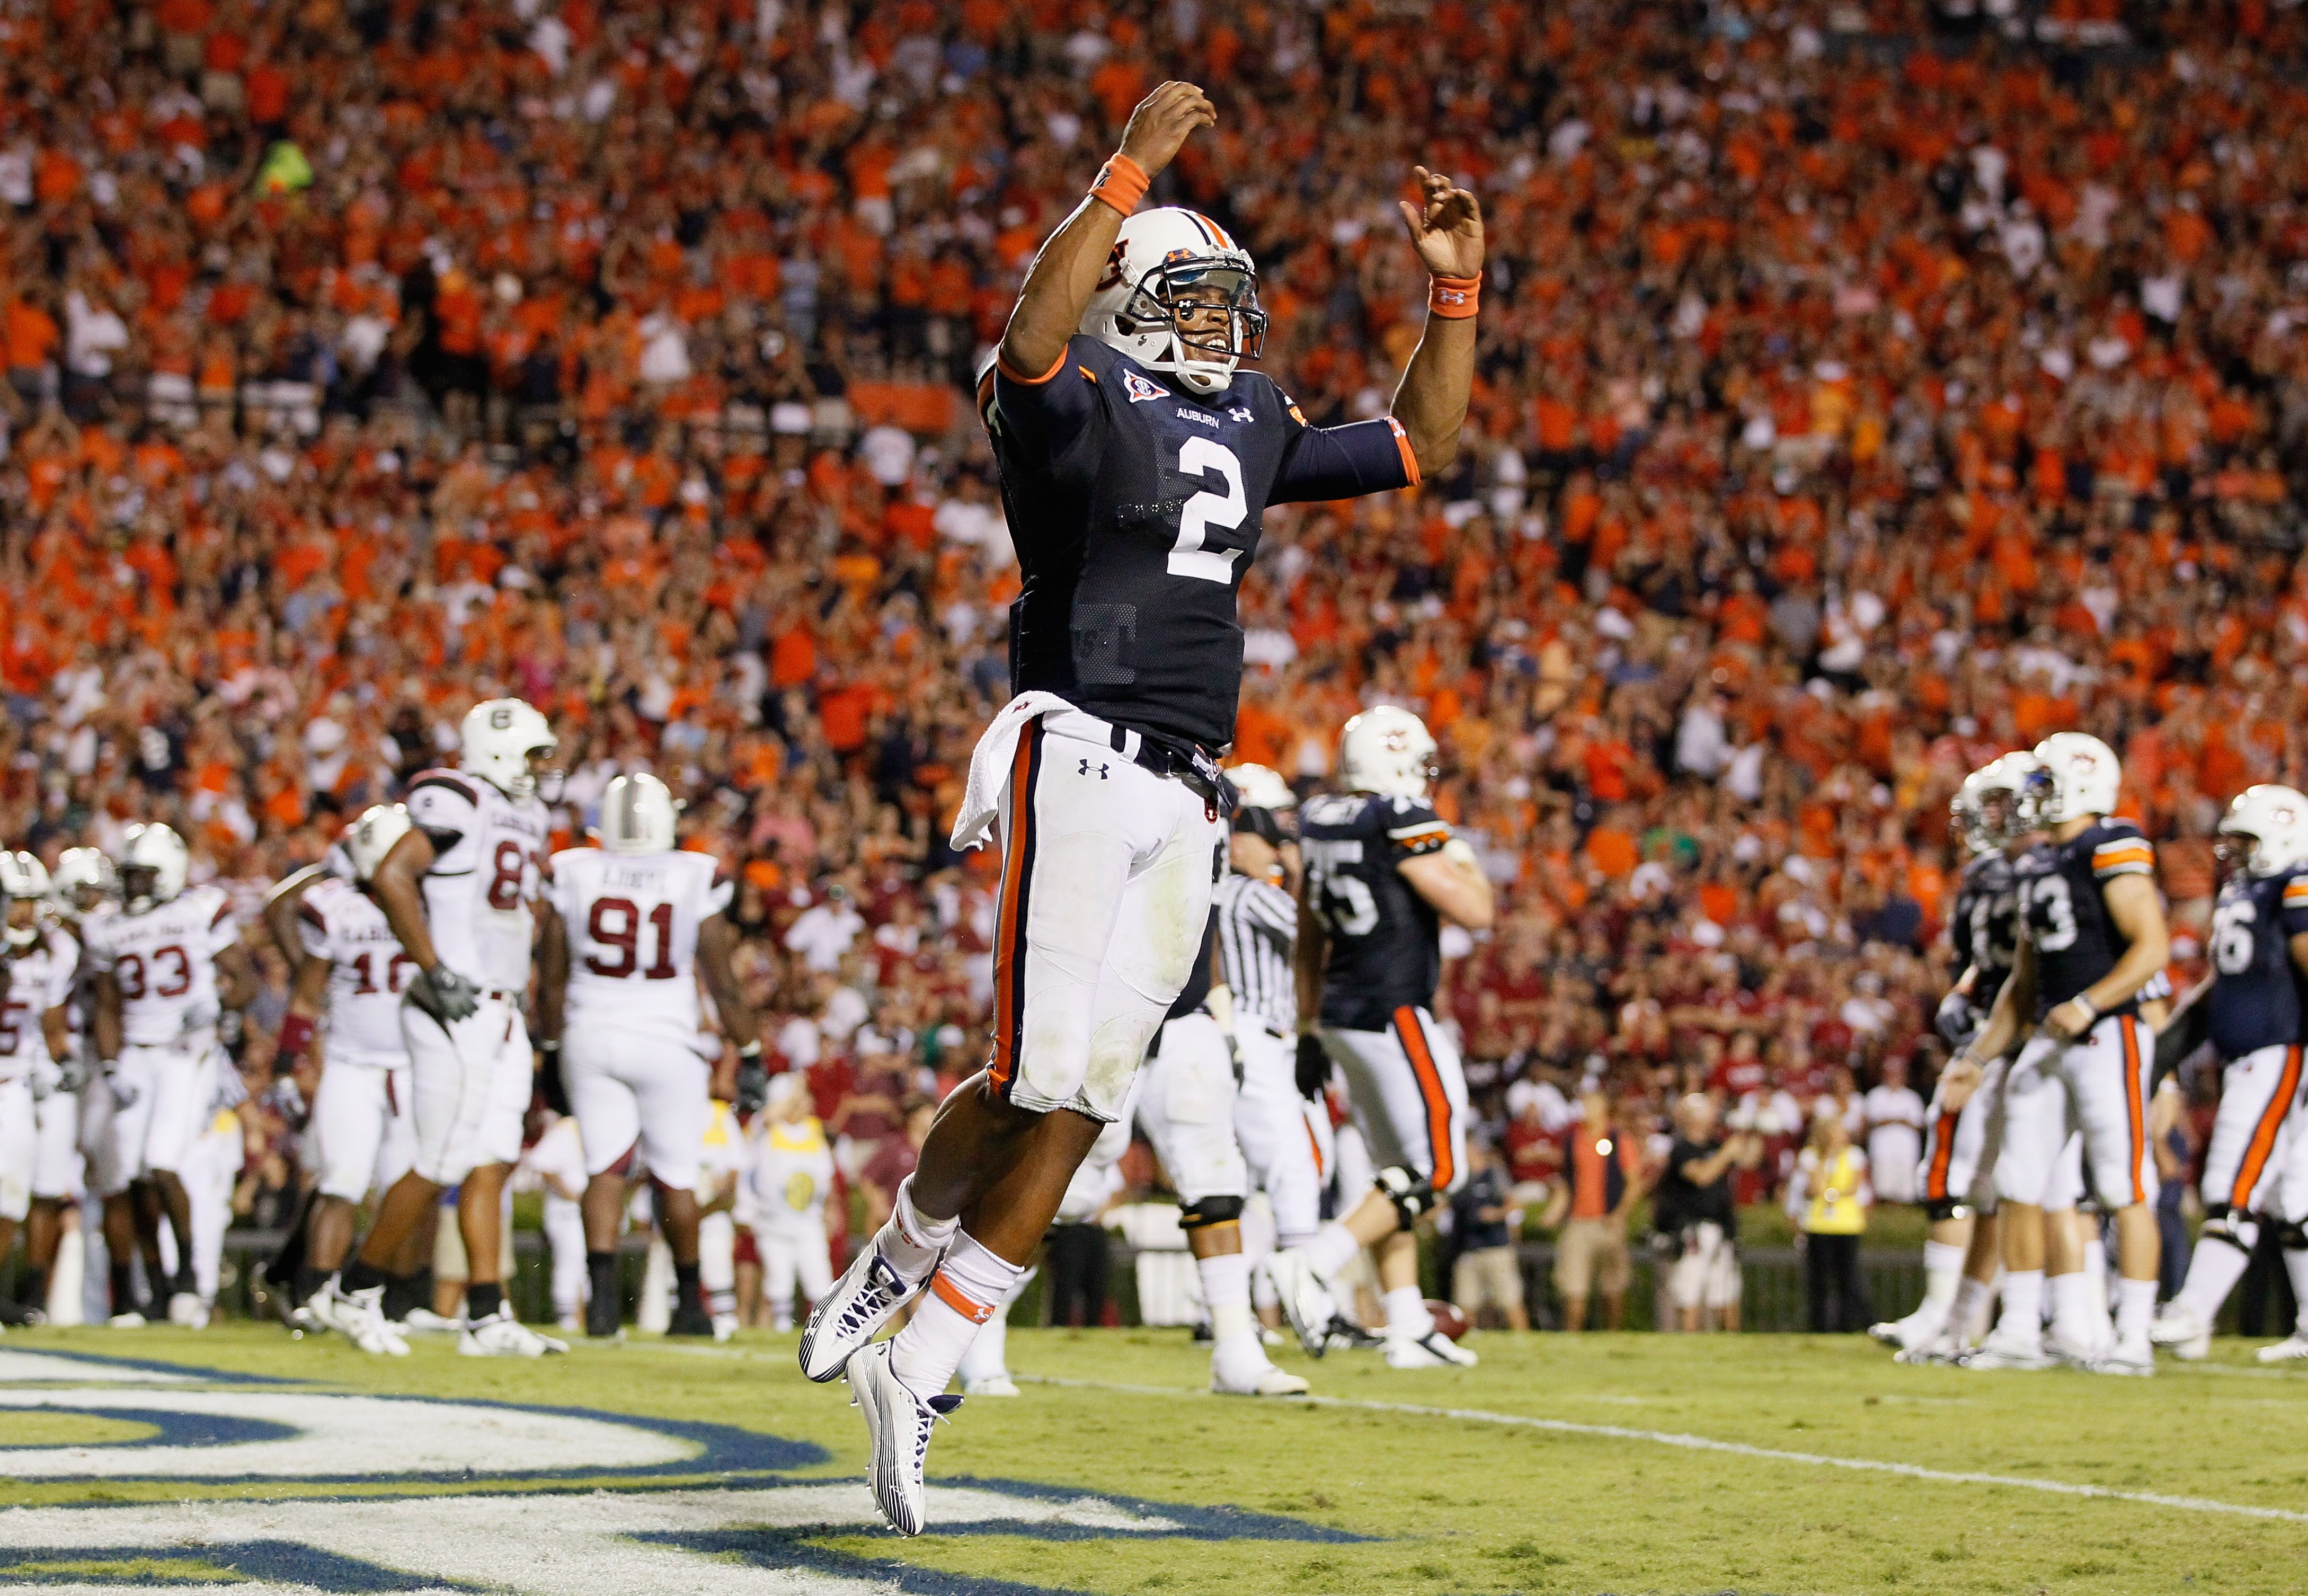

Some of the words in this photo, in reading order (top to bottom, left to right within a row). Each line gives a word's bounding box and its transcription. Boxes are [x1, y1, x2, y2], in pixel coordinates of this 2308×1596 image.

[1134, 380, 1152, 396] SEC
[1176, 407, 1220, 429] AUBURN
[1167, 436, 1248, 584] 2
[586, 897, 677, 979] 91
[117, 945, 191, 1000] 33
